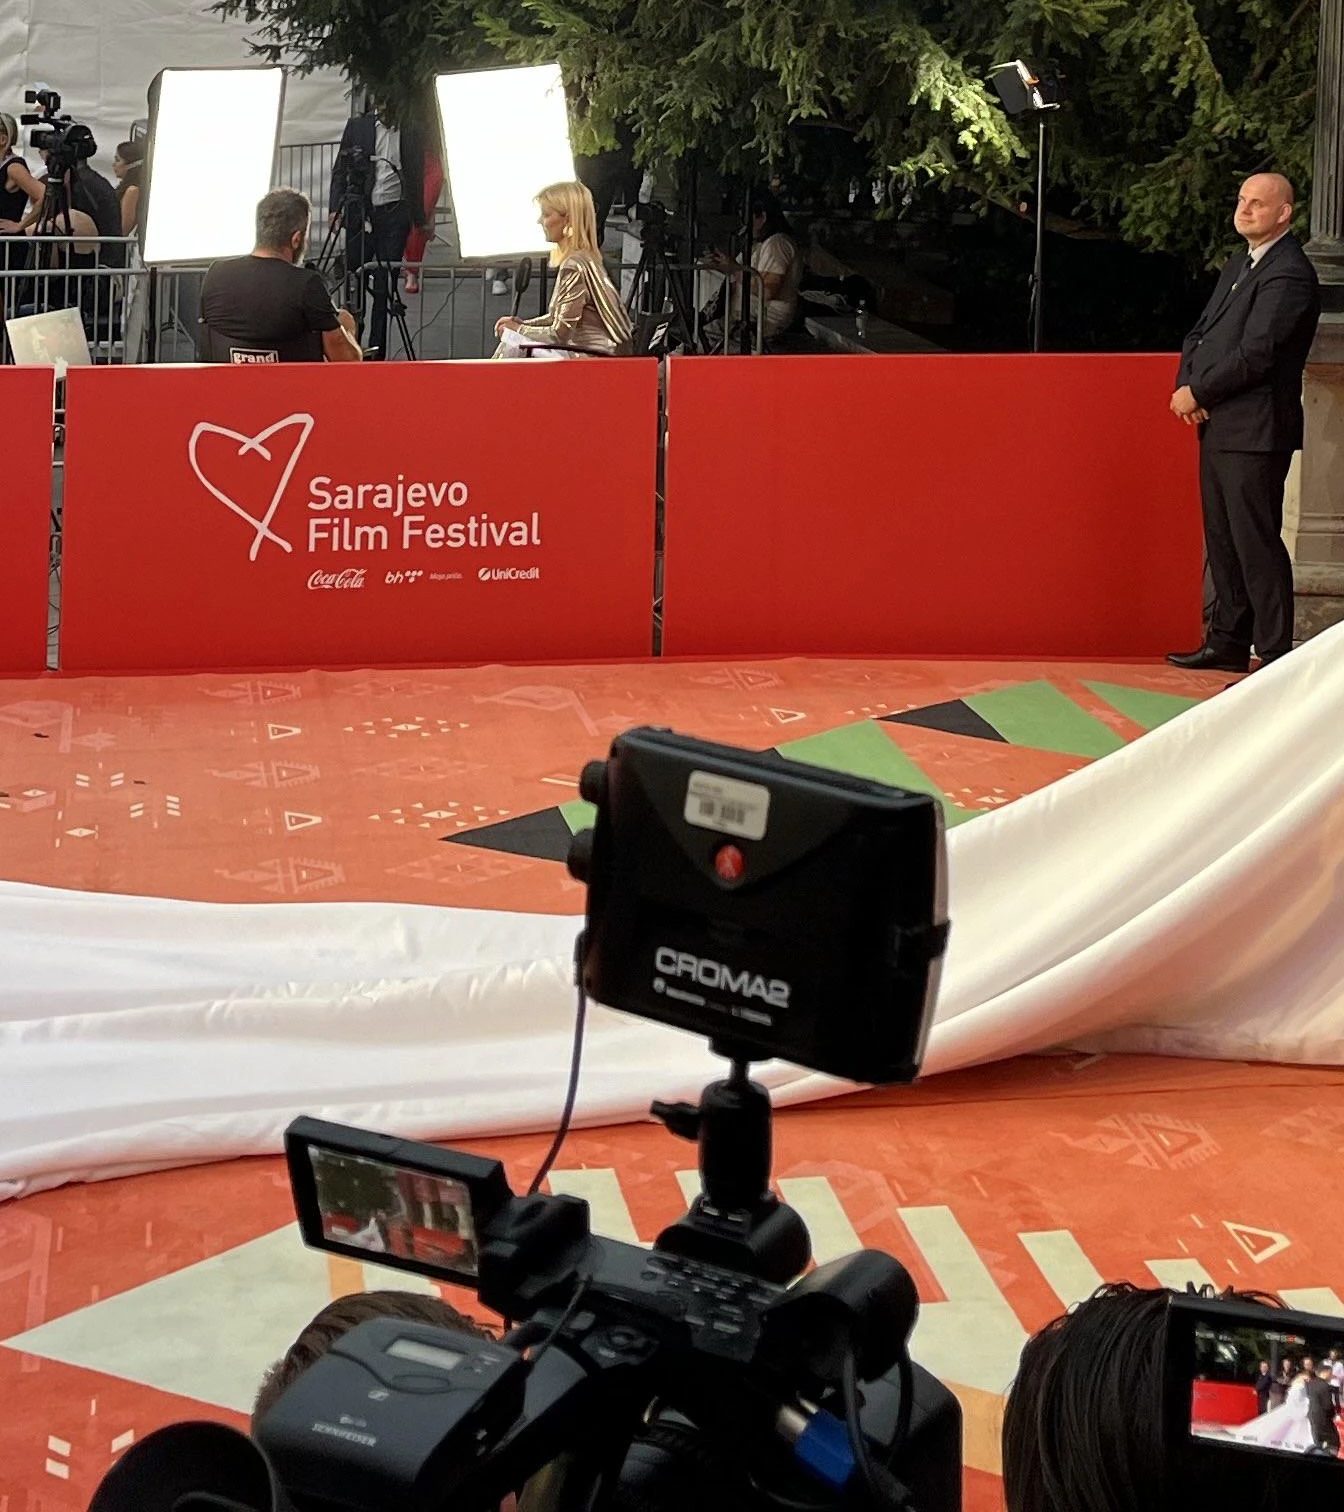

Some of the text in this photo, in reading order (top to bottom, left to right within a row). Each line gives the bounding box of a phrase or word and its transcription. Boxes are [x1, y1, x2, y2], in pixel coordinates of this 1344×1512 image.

[233, 351, 276, 364] grand
[307, 474, 468, 517] Sarajevo
[308, 512, 541, 552] Film Festival
[307, 568, 368, 590] Coca-Cola
[491, 567, 540, 581] UniCredit
[655, 945, 792, 1009] CROMA2
